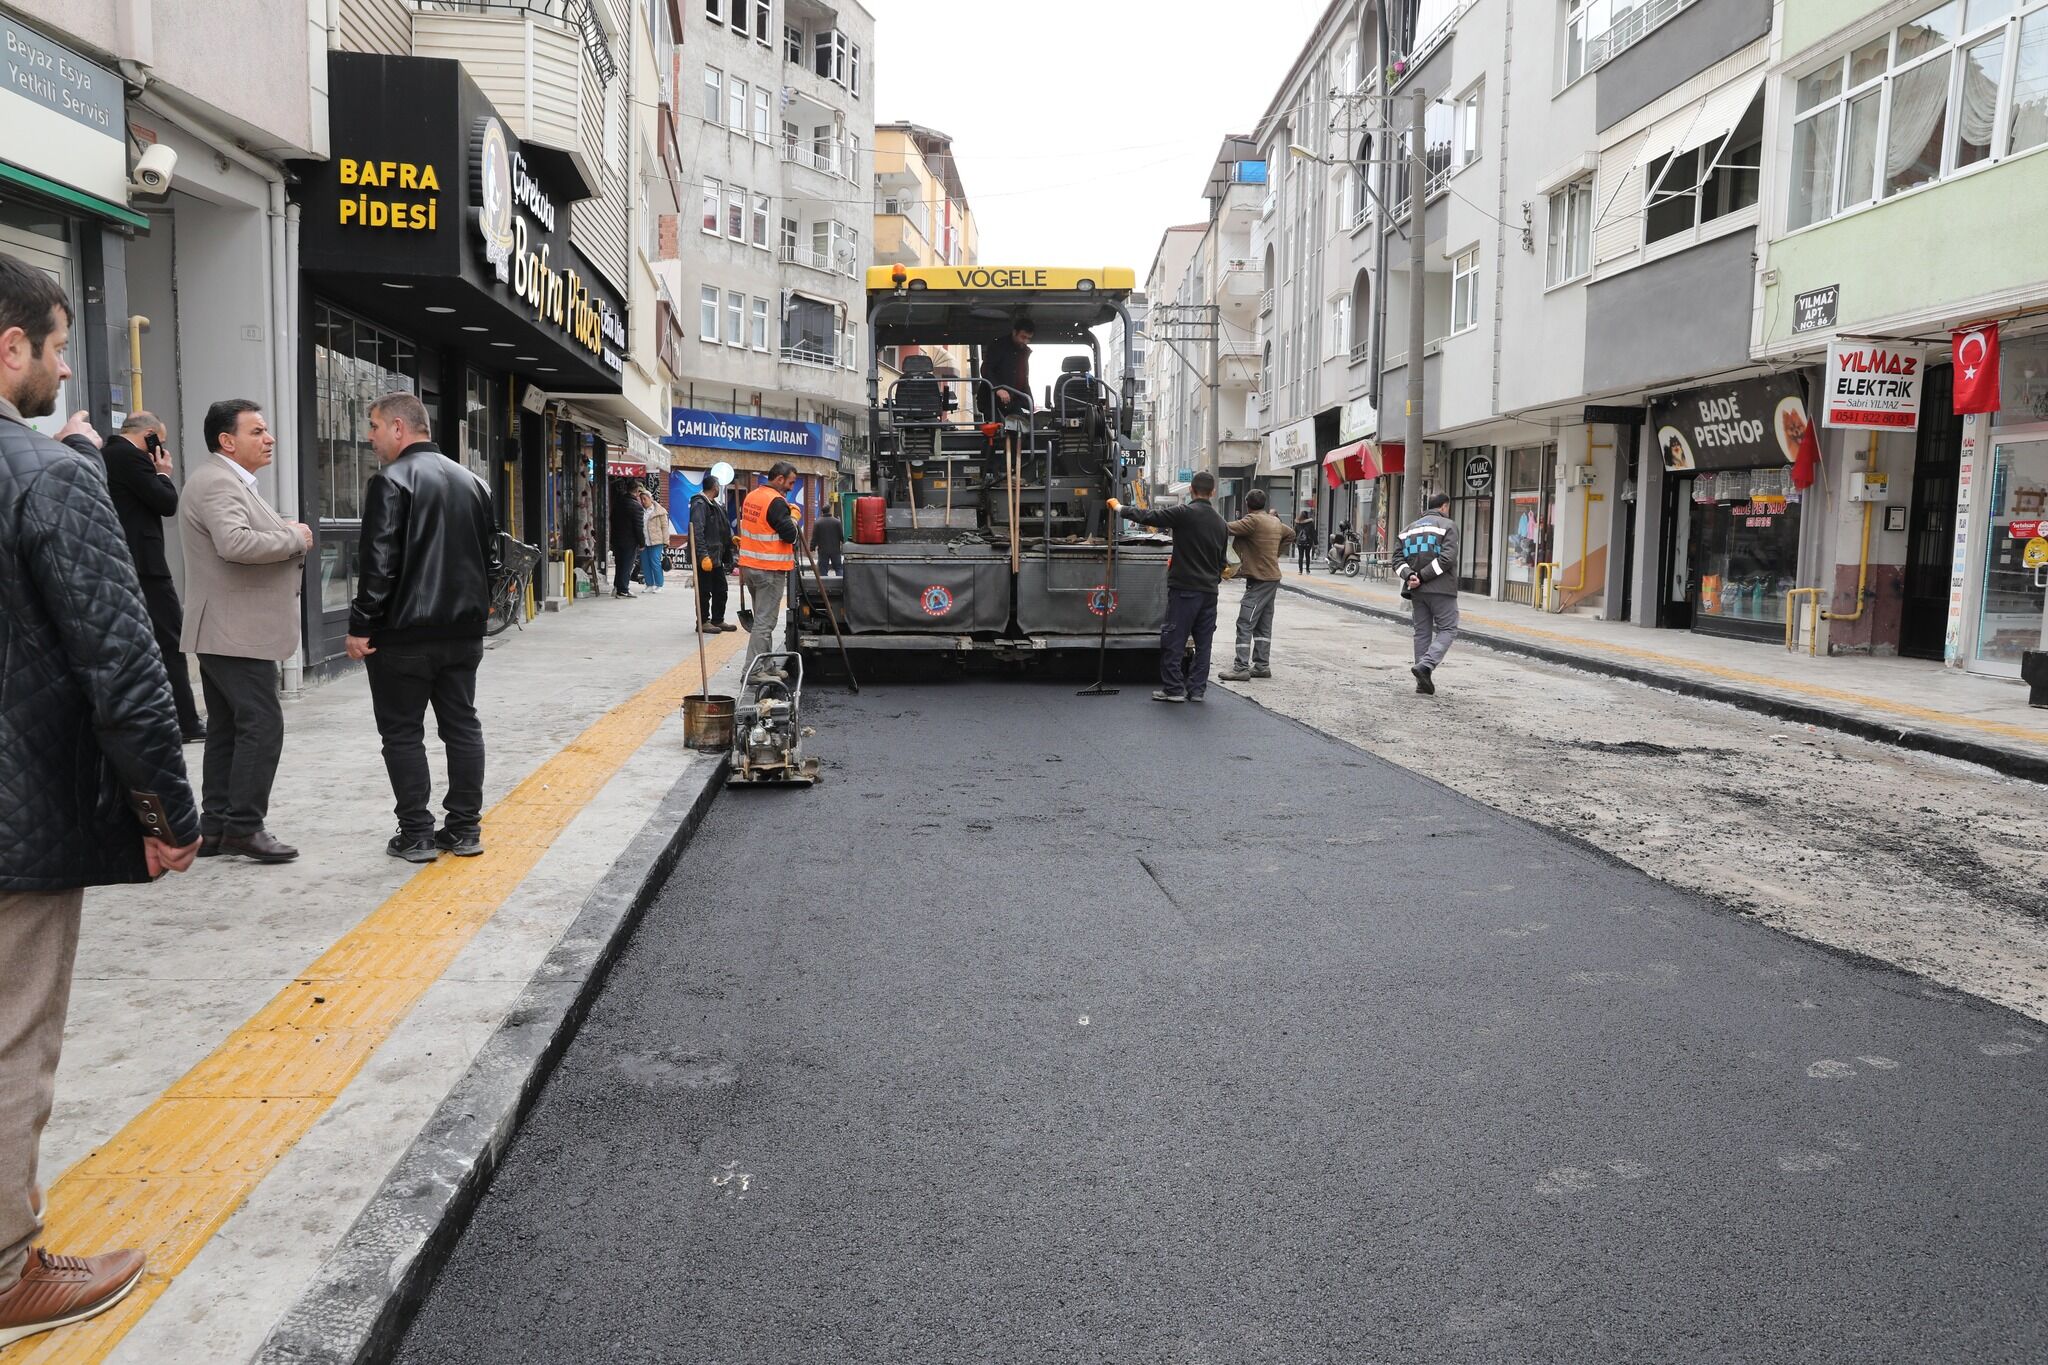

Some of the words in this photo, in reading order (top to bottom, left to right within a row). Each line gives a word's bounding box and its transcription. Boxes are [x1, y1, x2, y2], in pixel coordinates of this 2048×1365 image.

[6, 30, 53, 71] Beyaz
[8, 61, 56, 103] Yetkili
[62, 89, 110, 127] Servisi
[340, 158, 440, 191] BAFRA
[513, 151, 555, 234] Çörekotu
[340, 193, 437, 230] PİDESİ
[514, 214, 563, 326] Bafra
[956, 266, 1047, 288] VÖGELE
[1799, 290, 1834, 311] YILMAZ
[1804, 307, 1825, 321] APT.
[1800, 320, 1816, 330] NO:
[1839, 348, 1918, 375] YILMAZ
[1837, 376, 1914, 398] ELEKTRİK
[1698, 396, 1741, 423] BADE
[1847, 398, 1869, 408] Sabri
[1870, 399, 1900, 410] YILMAZ
[677, 419, 741, 442] ÇAMLIKÖŞK
[743, 428, 809, 446] RESTAURANT
[1694, 420, 1764, 448] PETSHOP
